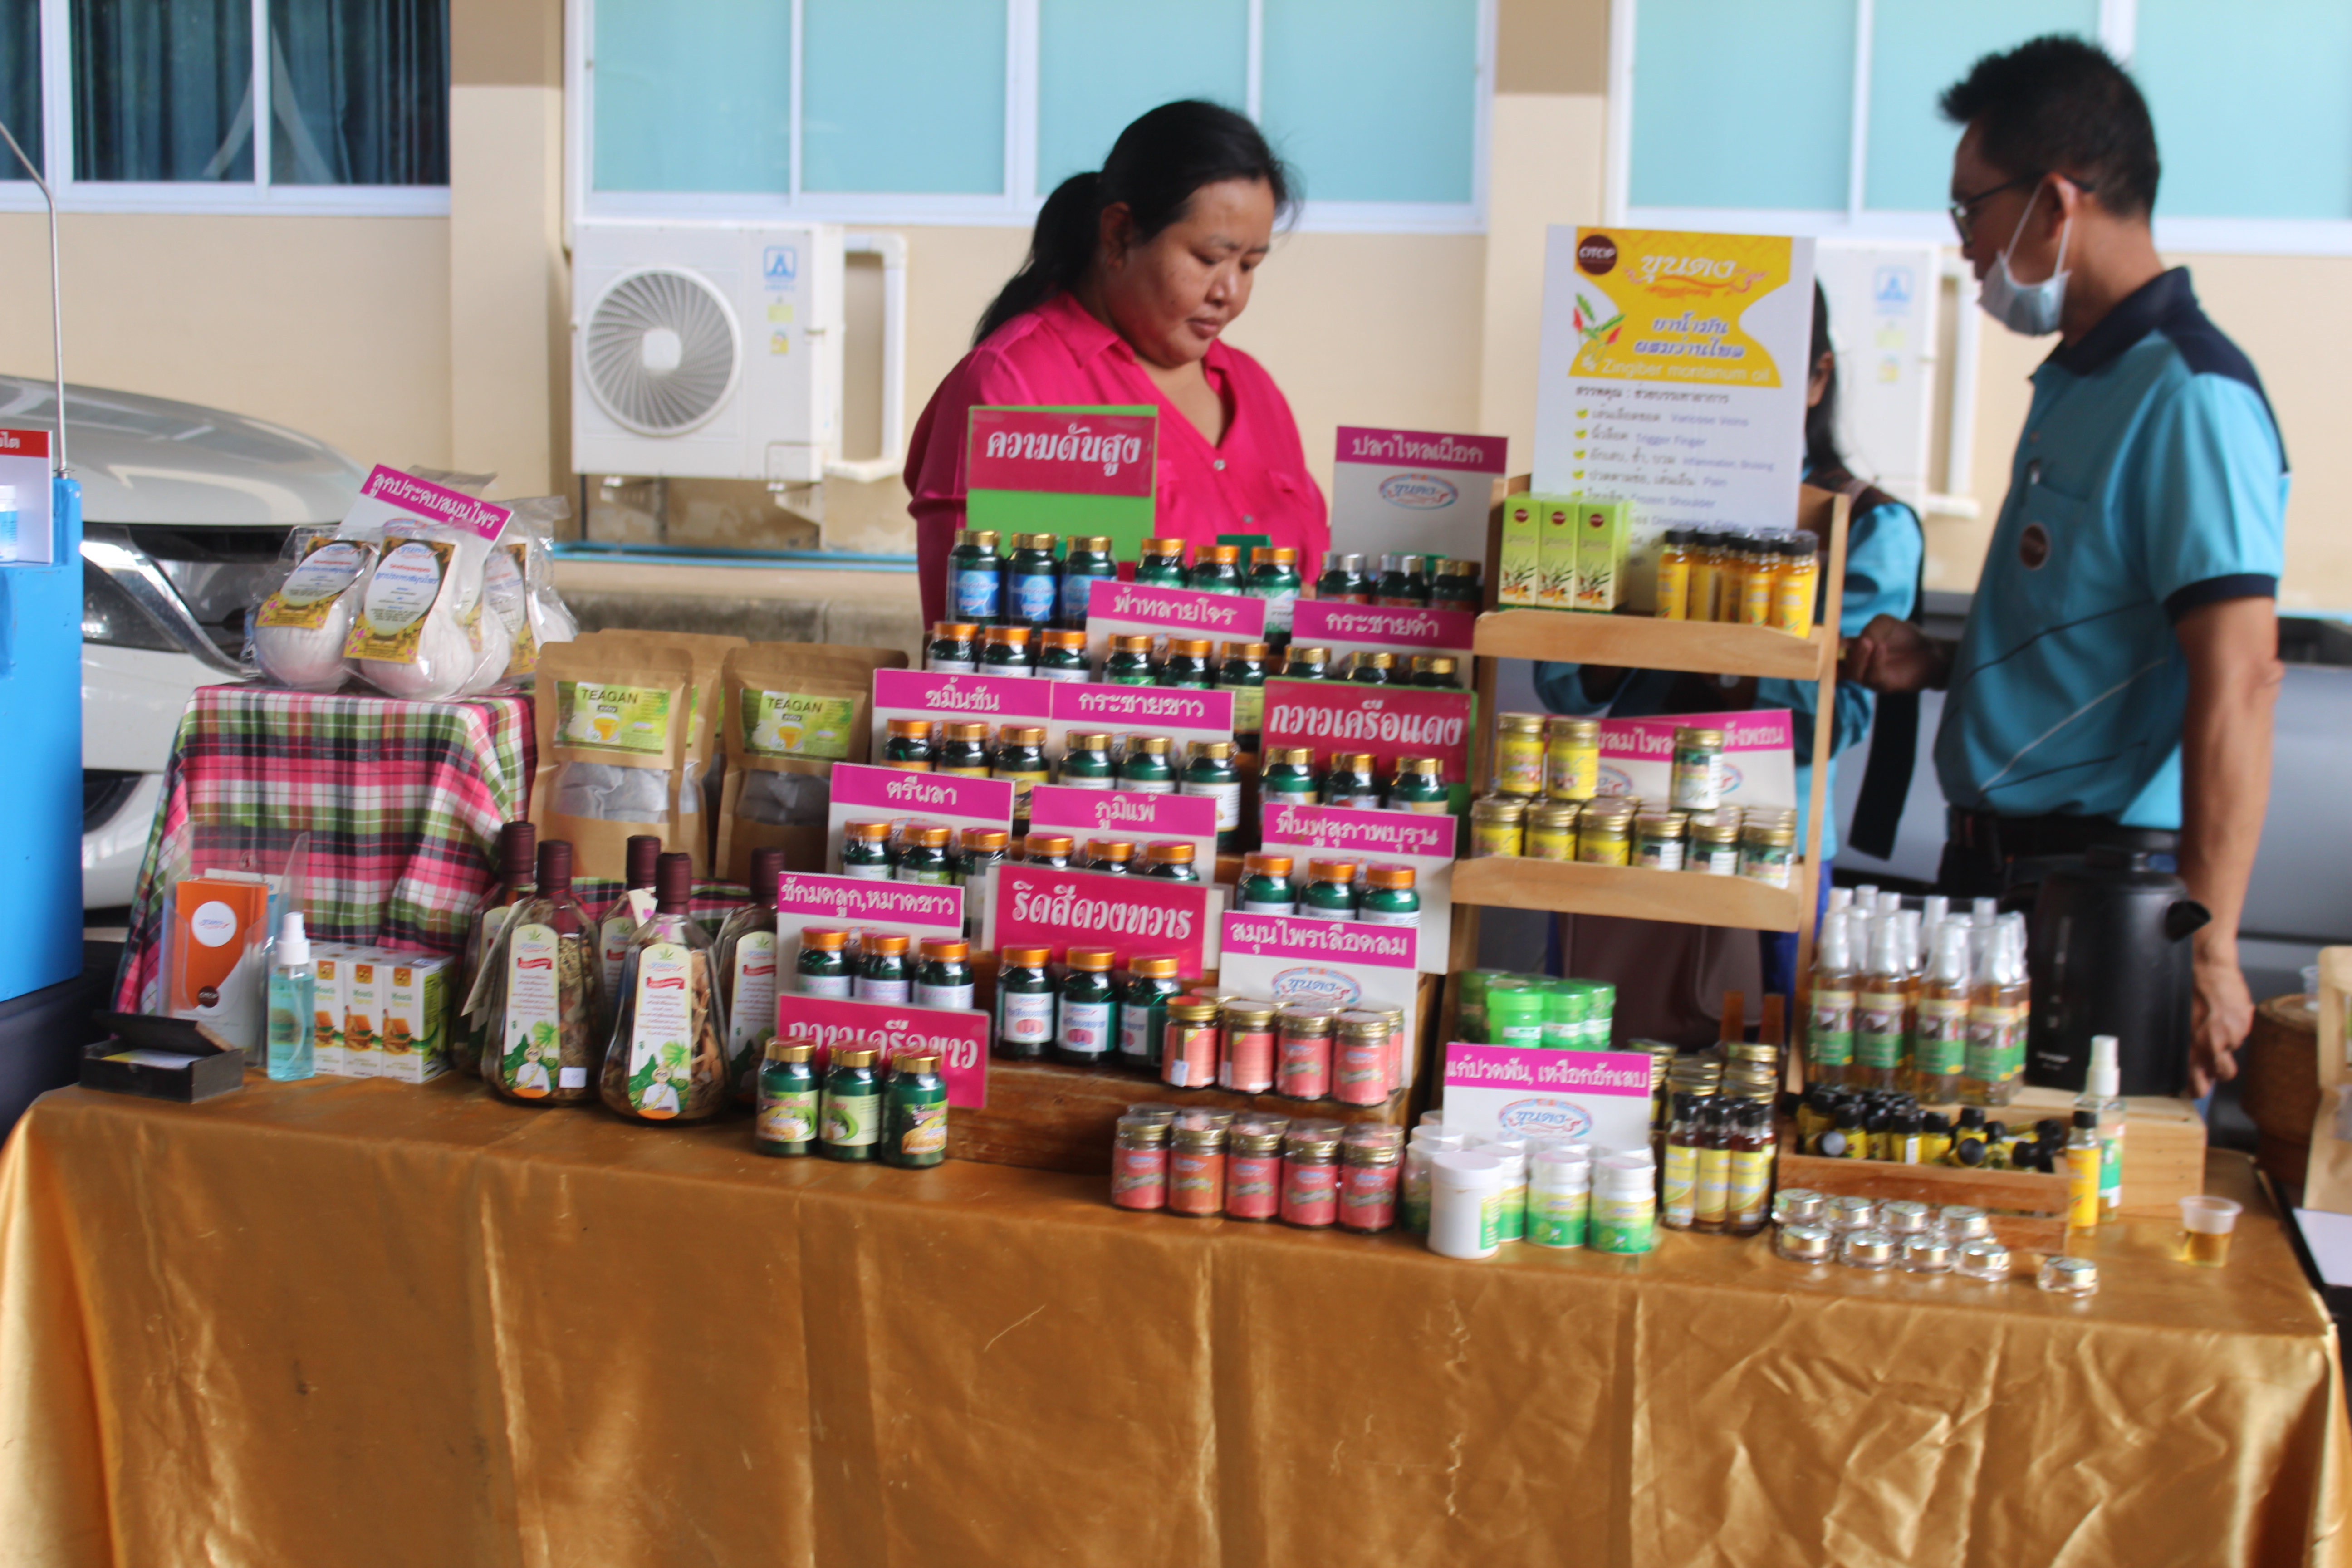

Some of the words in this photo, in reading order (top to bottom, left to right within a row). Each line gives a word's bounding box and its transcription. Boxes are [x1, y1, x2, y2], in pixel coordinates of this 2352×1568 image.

[986, 423, 1142, 477] ความดันสูง
[1352, 434, 1484, 464] ปลาไหลเผือก
[368, 473, 500, 529] ลูกประคบสมุนไพร
[1112, 587, 1237, 625] ฟ้าทลายโจร
[1326, 611, 1439, 638] กระชายดำ
[925, 676, 1000, 712] ขมิ้นชัน
[1078, 692, 1205, 718] กระชายขาว
[1269, 699, 1463, 746] กวาวเครือแดง
[886, 774, 958, 806] ตรีผลา
[1094, 793, 1157, 831] ภูมิแพ้
[1012, 879, 1194, 940] ริดสีดวงทวาร
[1230, 918, 1408, 956] สมุนไพรเลือดลม
